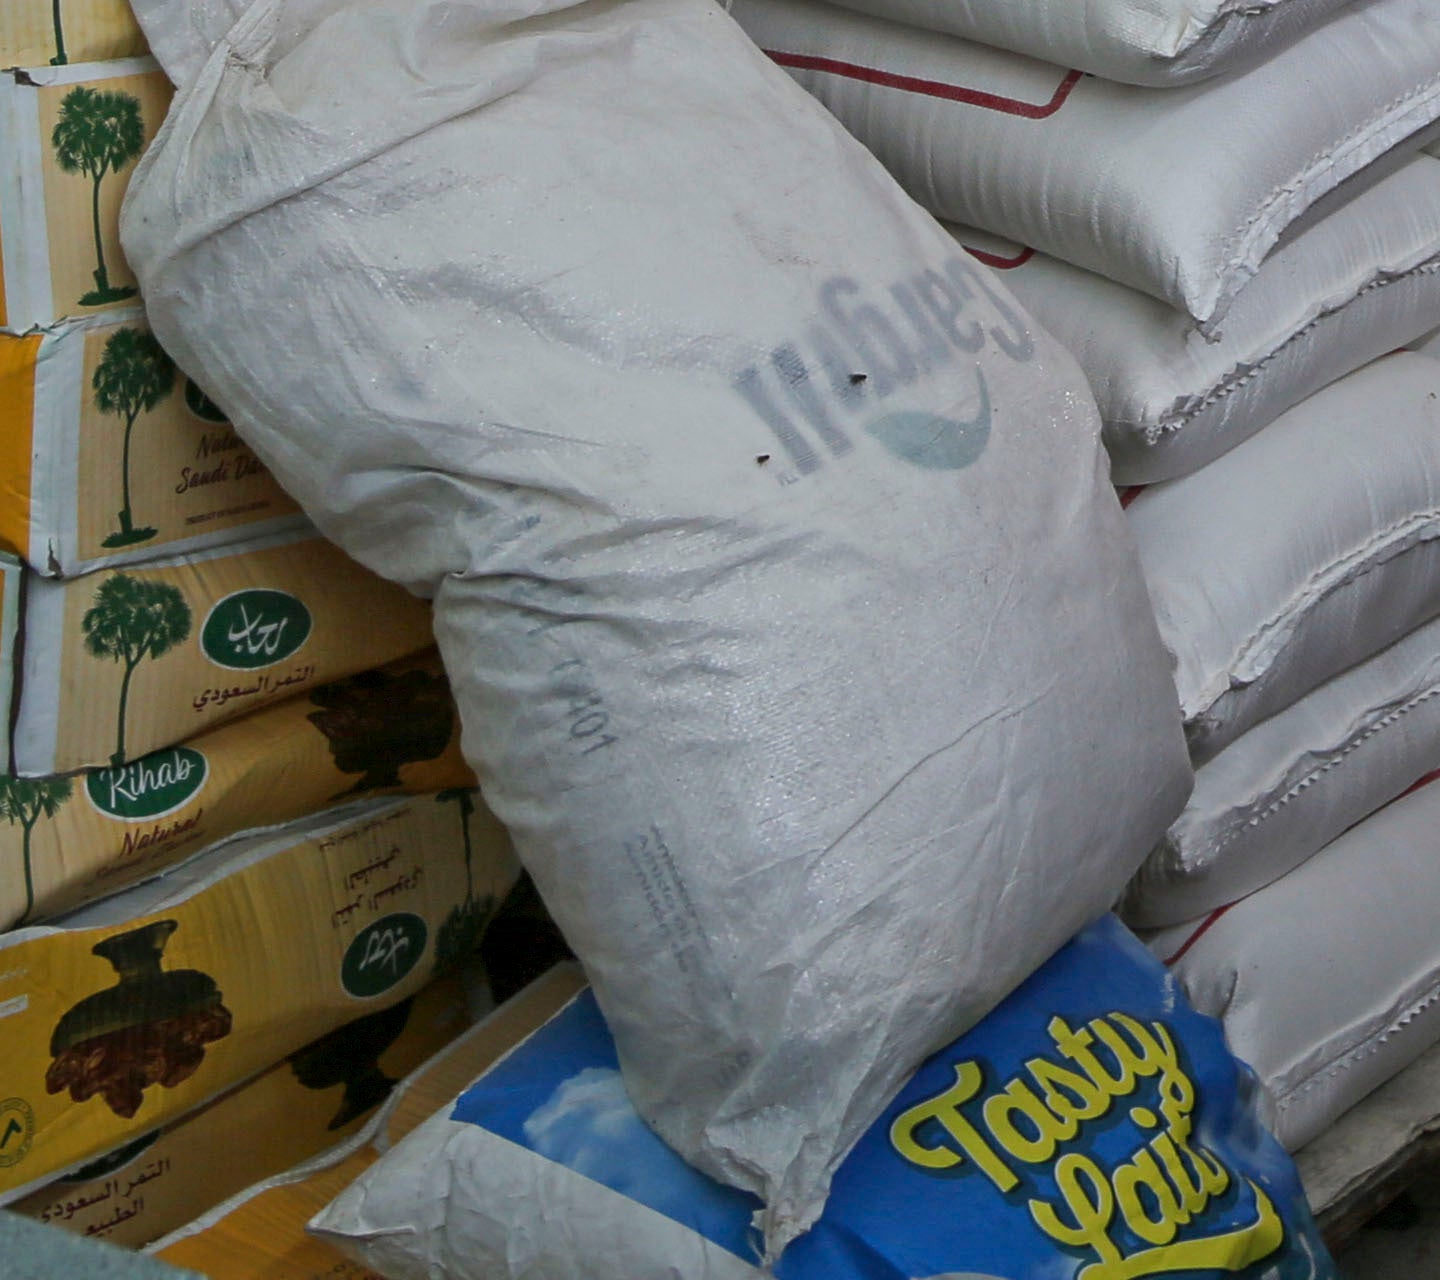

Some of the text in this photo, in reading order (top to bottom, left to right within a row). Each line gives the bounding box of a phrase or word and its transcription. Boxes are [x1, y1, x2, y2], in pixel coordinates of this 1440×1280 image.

[191, 664, 317, 713] التمر السعودي
[98, 753, 198, 809] Rihab
[890, 1010, 1195, 1192] Tasty
